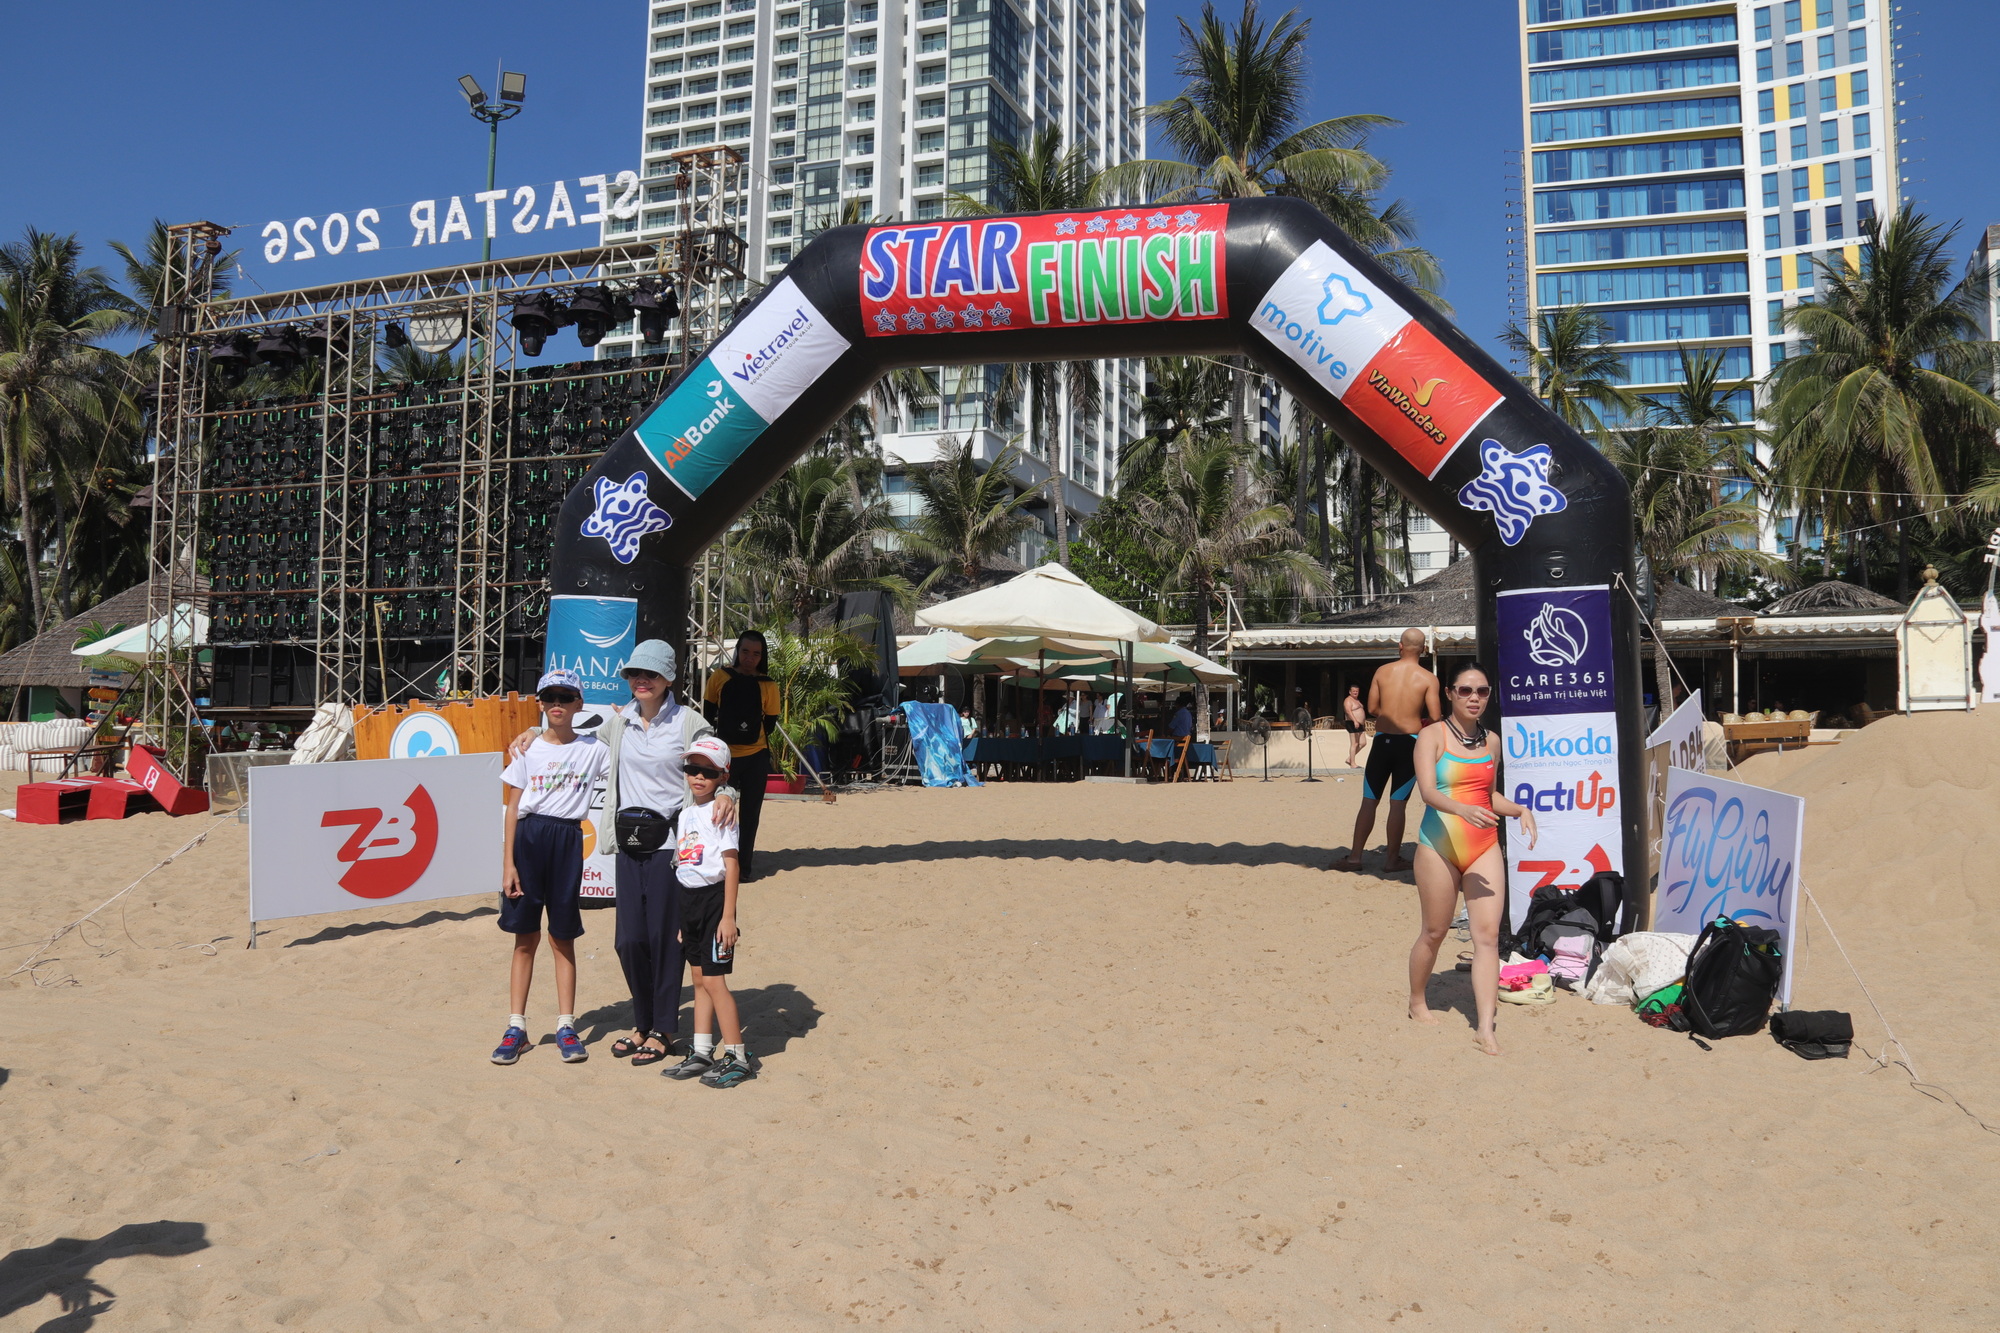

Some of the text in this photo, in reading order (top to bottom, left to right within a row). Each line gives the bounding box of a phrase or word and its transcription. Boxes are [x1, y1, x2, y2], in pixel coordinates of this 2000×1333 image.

[863, 223, 1021, 301] STAR
[1027, 231, 1219, 324] FINISH
[732, 308, 810, 382] Vietravel
[750, 323, 814, 385] YOUR JOURNEY YOUR VALUE
[1260, 299, 1347, 380] motive
[663, 396, 736, 470] ABBank
[1367, 368, 1448, 445] VinWonders
[591, 681, 619, 691] BEACH
[1510, 671, 1605, 688] CARE365
[1510, 693, 1531, 702] Nâng
[1568, 689, 1588, 699] Liệu
[1590, 688, 1607, 698] Việt
[1507, 722, 1612, 759] Vikoda
[1513, 770, 1615, 820] ActiUp
[583, 866, 601, 881] ỂM
